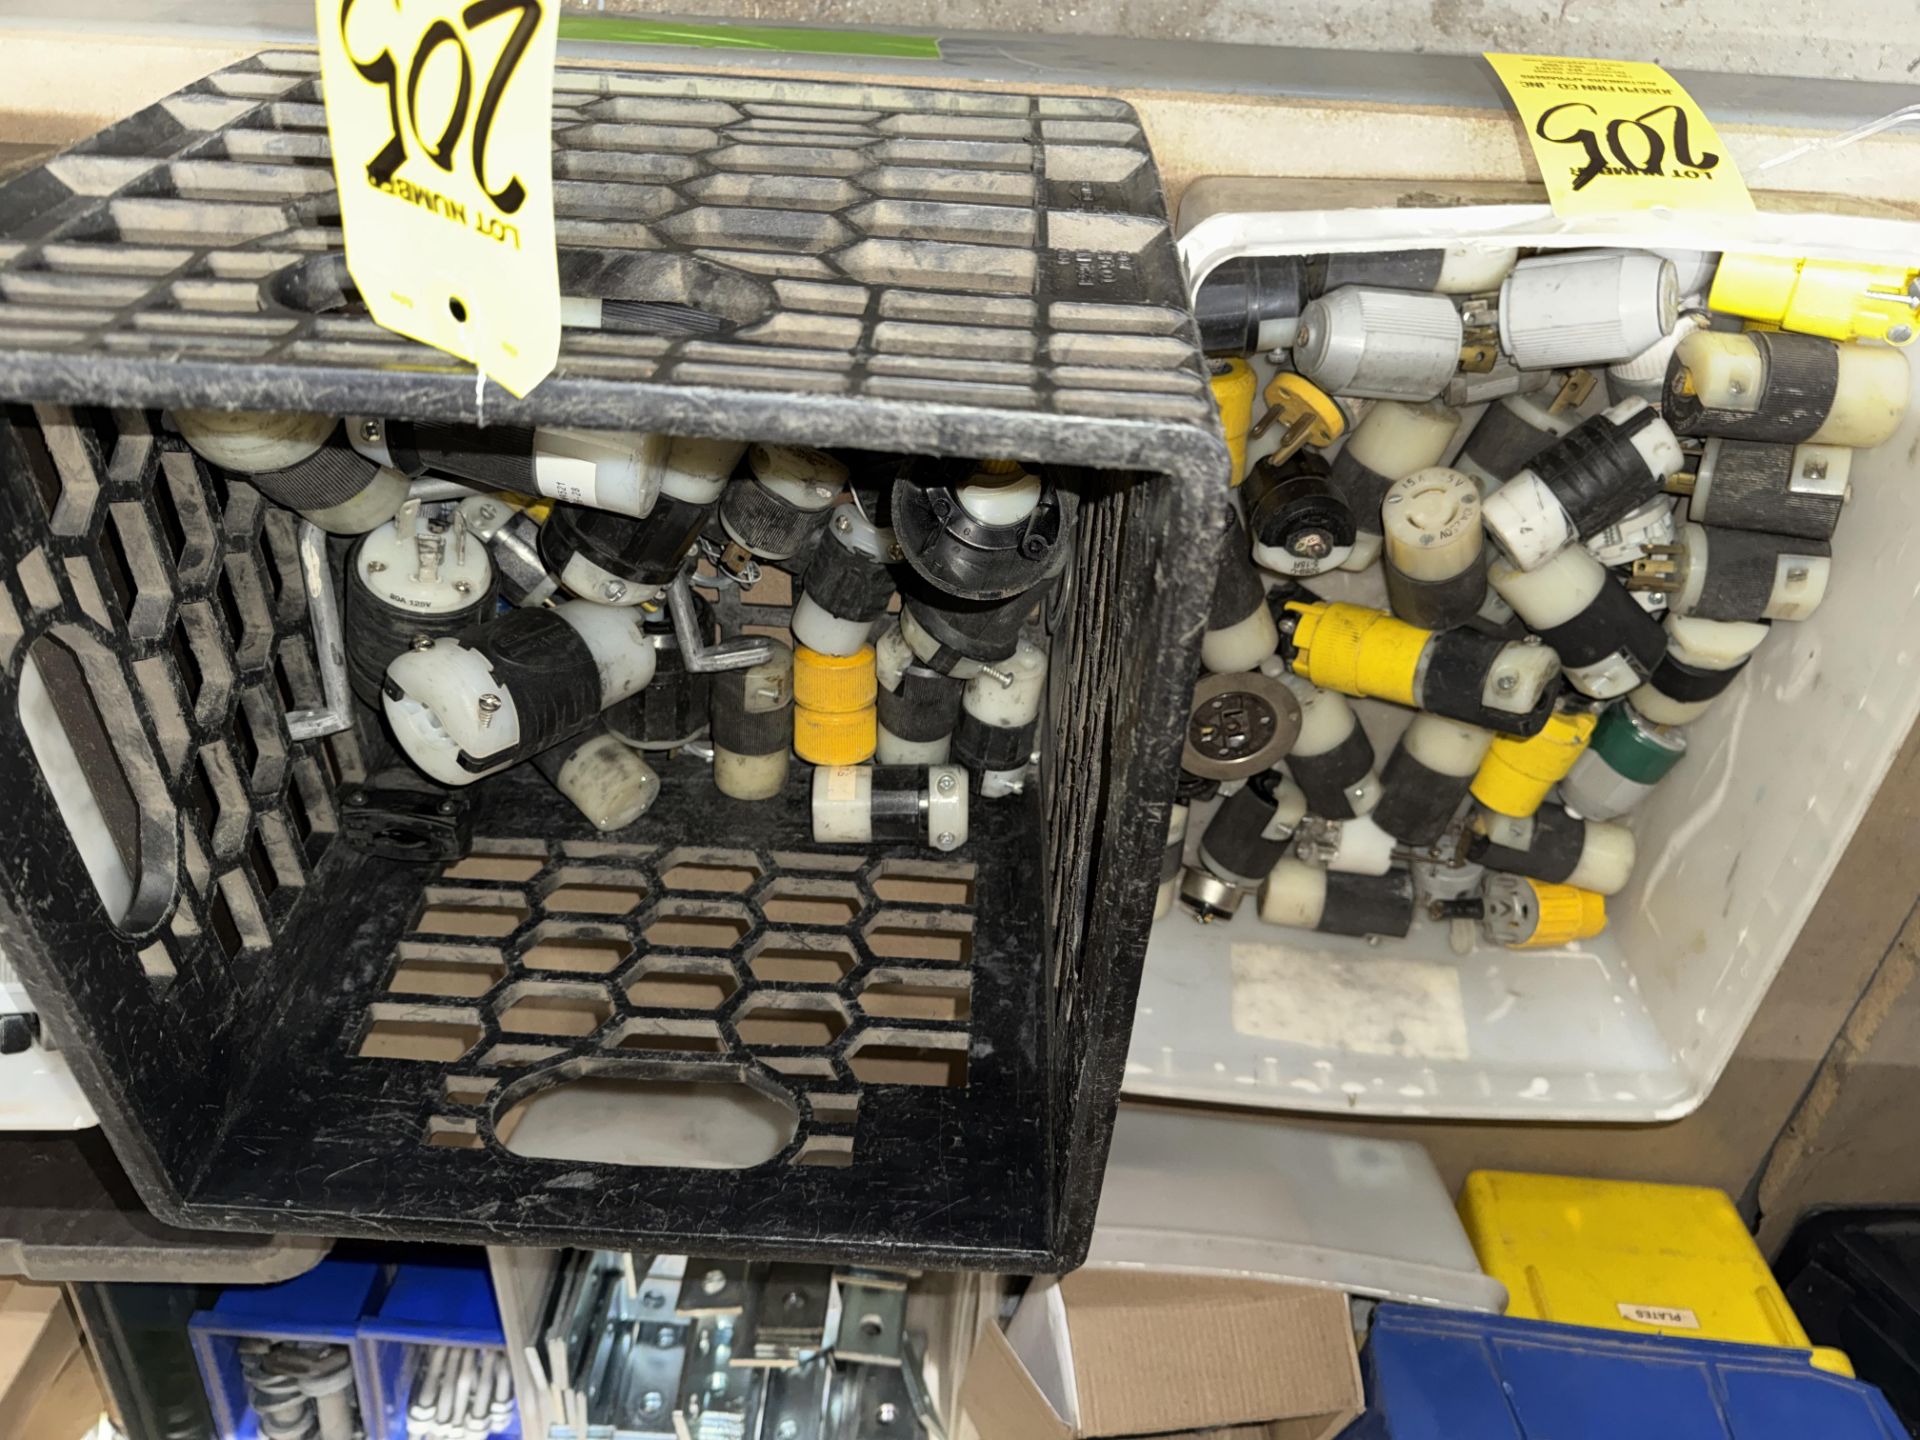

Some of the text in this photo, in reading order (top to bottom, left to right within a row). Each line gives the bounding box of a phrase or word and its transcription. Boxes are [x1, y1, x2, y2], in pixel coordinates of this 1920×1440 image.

[1581, 84, 1616, 93] FINN
[341, 0, 542, 214] 205
[1536, 102, 1719, 191] 205
[1672, 169, 1713, 180] LOT
[477, 211, 520, 250] LOT
[1635, 1309, 1682, 1322] PLATES
